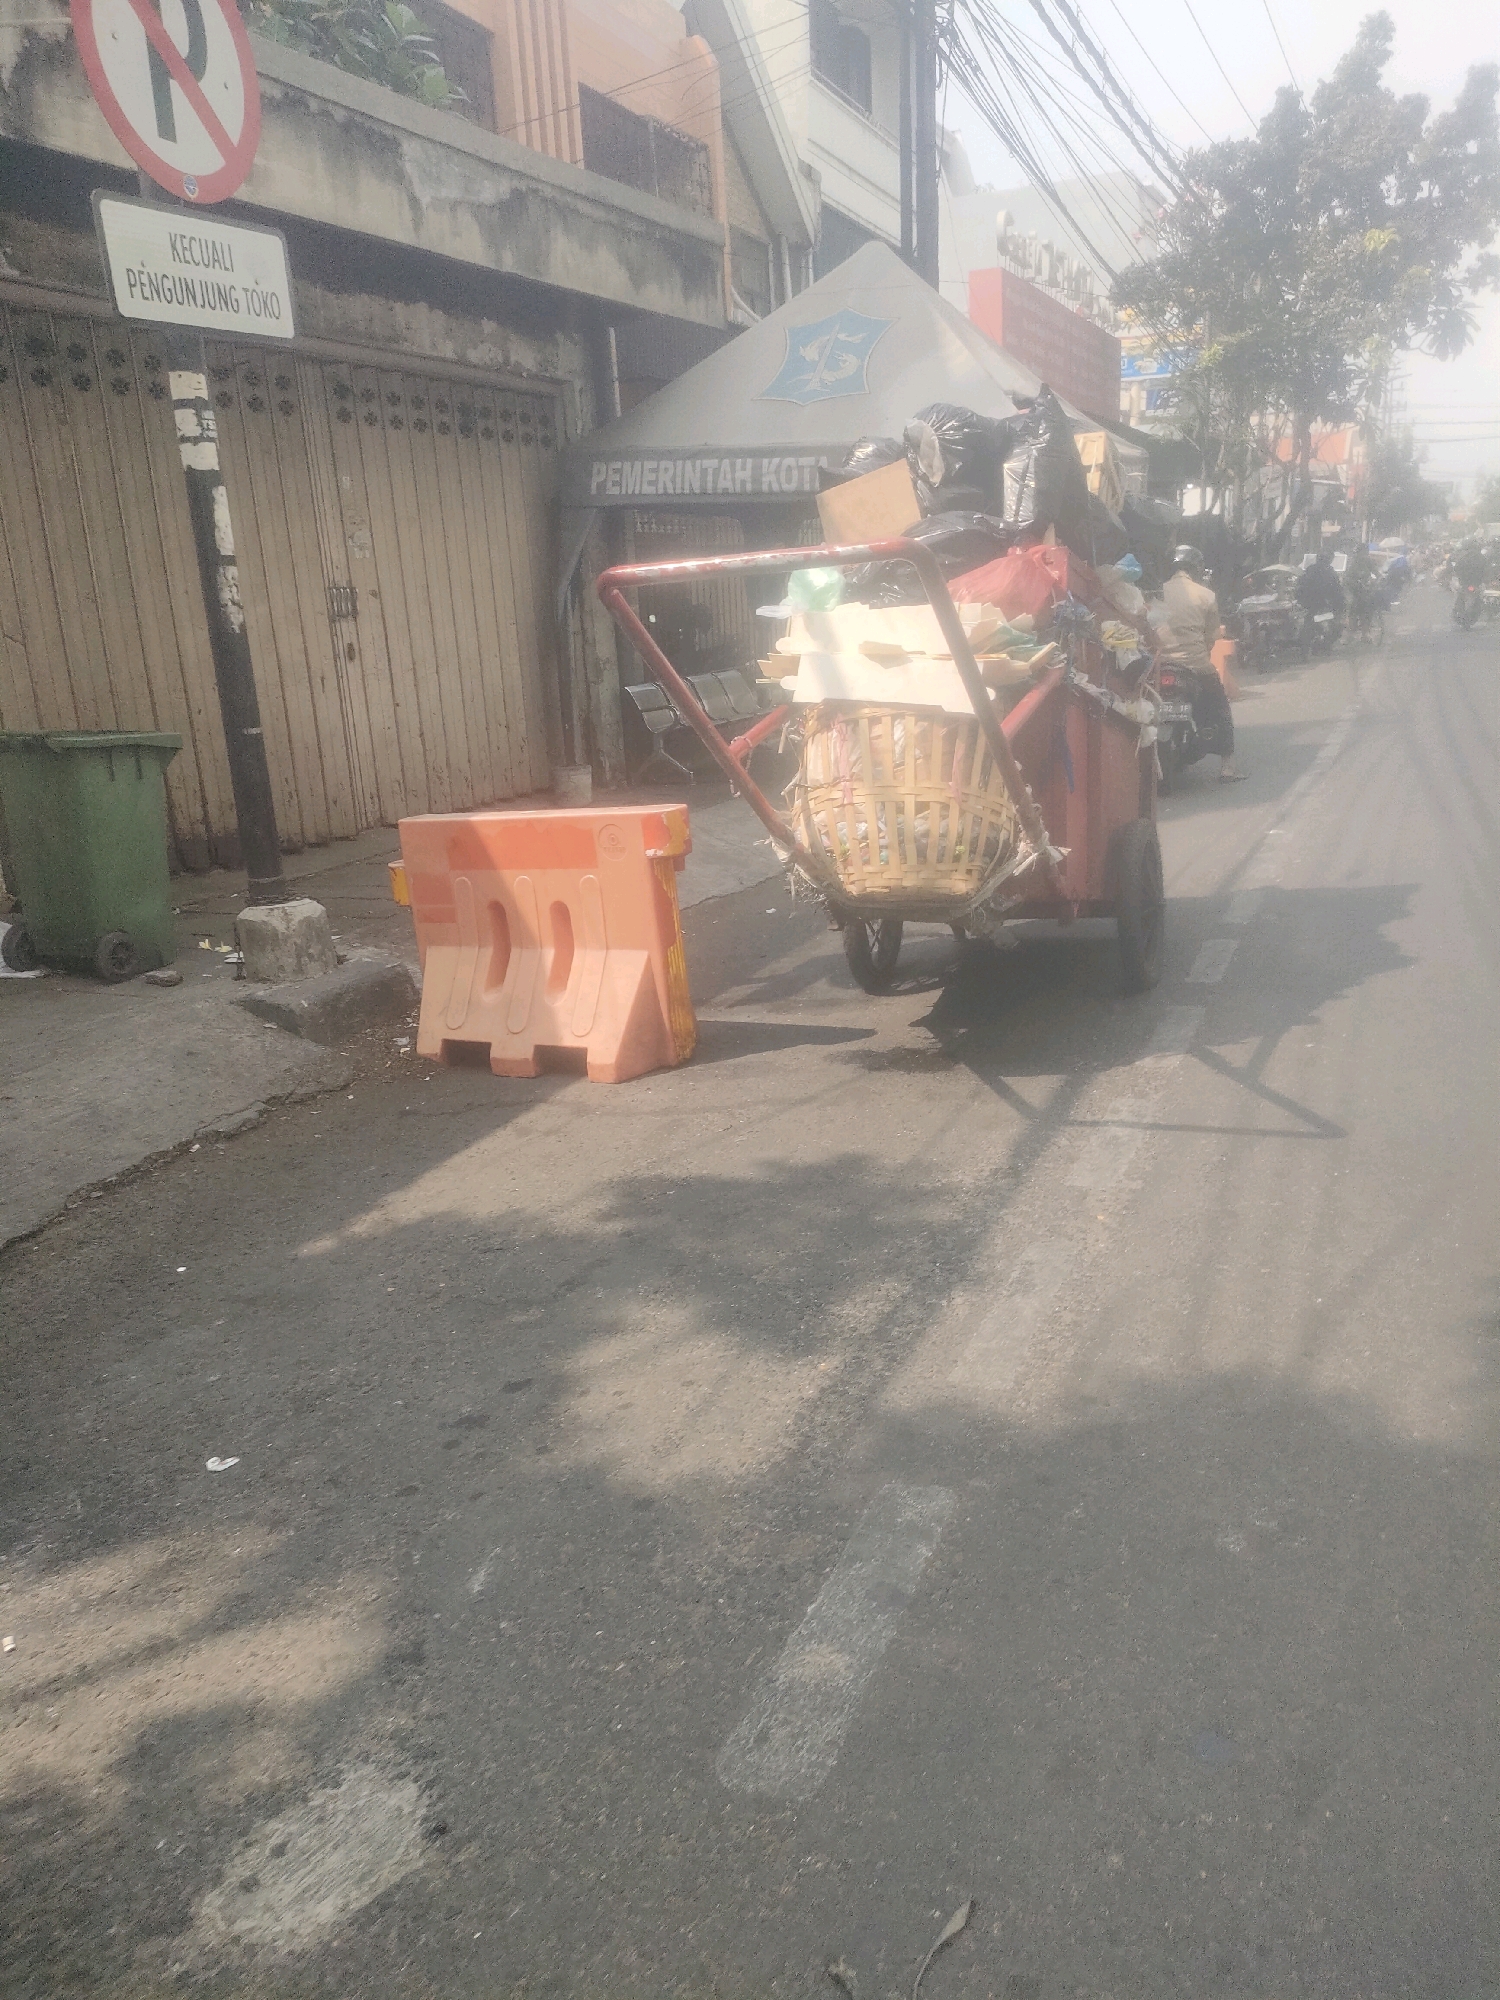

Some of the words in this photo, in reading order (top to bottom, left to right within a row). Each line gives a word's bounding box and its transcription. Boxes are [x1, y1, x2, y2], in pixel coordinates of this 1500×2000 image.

[169, 232, 234, 272] KECUALI
[126, 267, 240, 314] PENGUNJUNG
[242, 287, 281, 320] TOKO
[590, 458, 752, 495] PEMERINTAH
